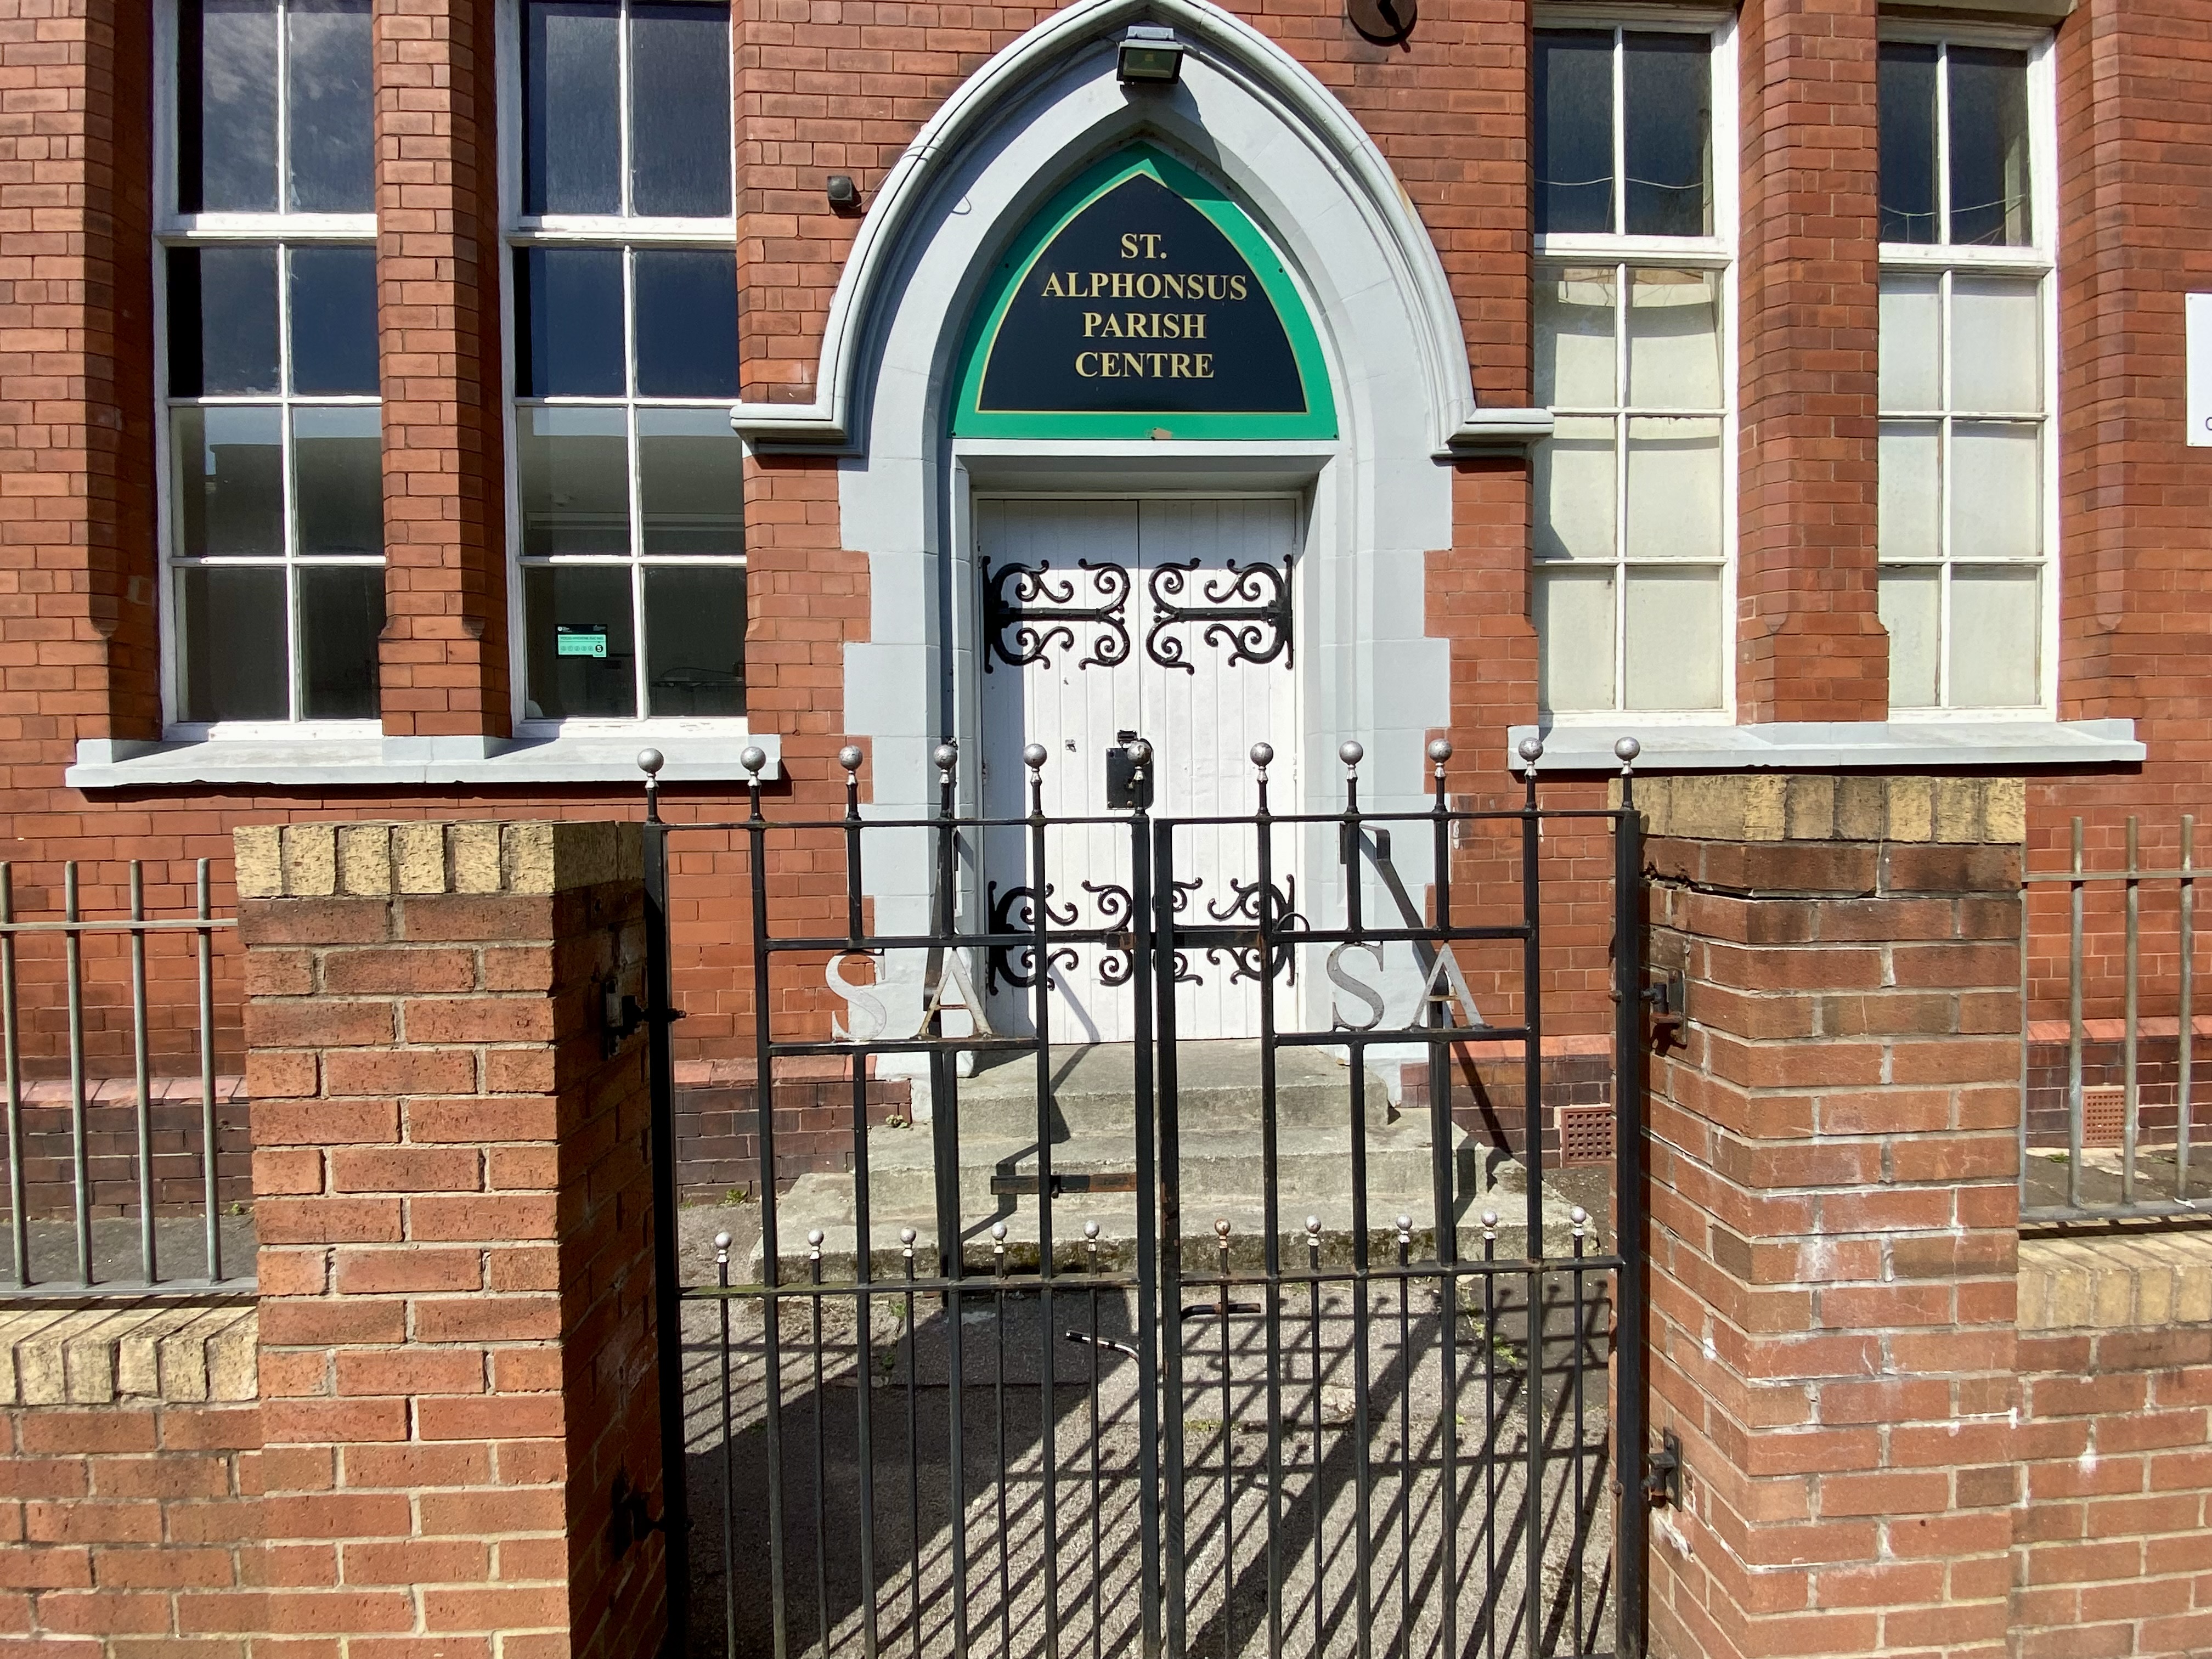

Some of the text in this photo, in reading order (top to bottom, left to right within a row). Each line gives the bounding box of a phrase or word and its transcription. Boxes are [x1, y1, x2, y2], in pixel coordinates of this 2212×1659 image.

[1121, 233, 1167, 258] ST.
[1041, 272, 1247, 300] ALPHONSUS
[1082, 312, 1206, 338] PARISH
[1075, 352, 1214, 379] CENTRE
